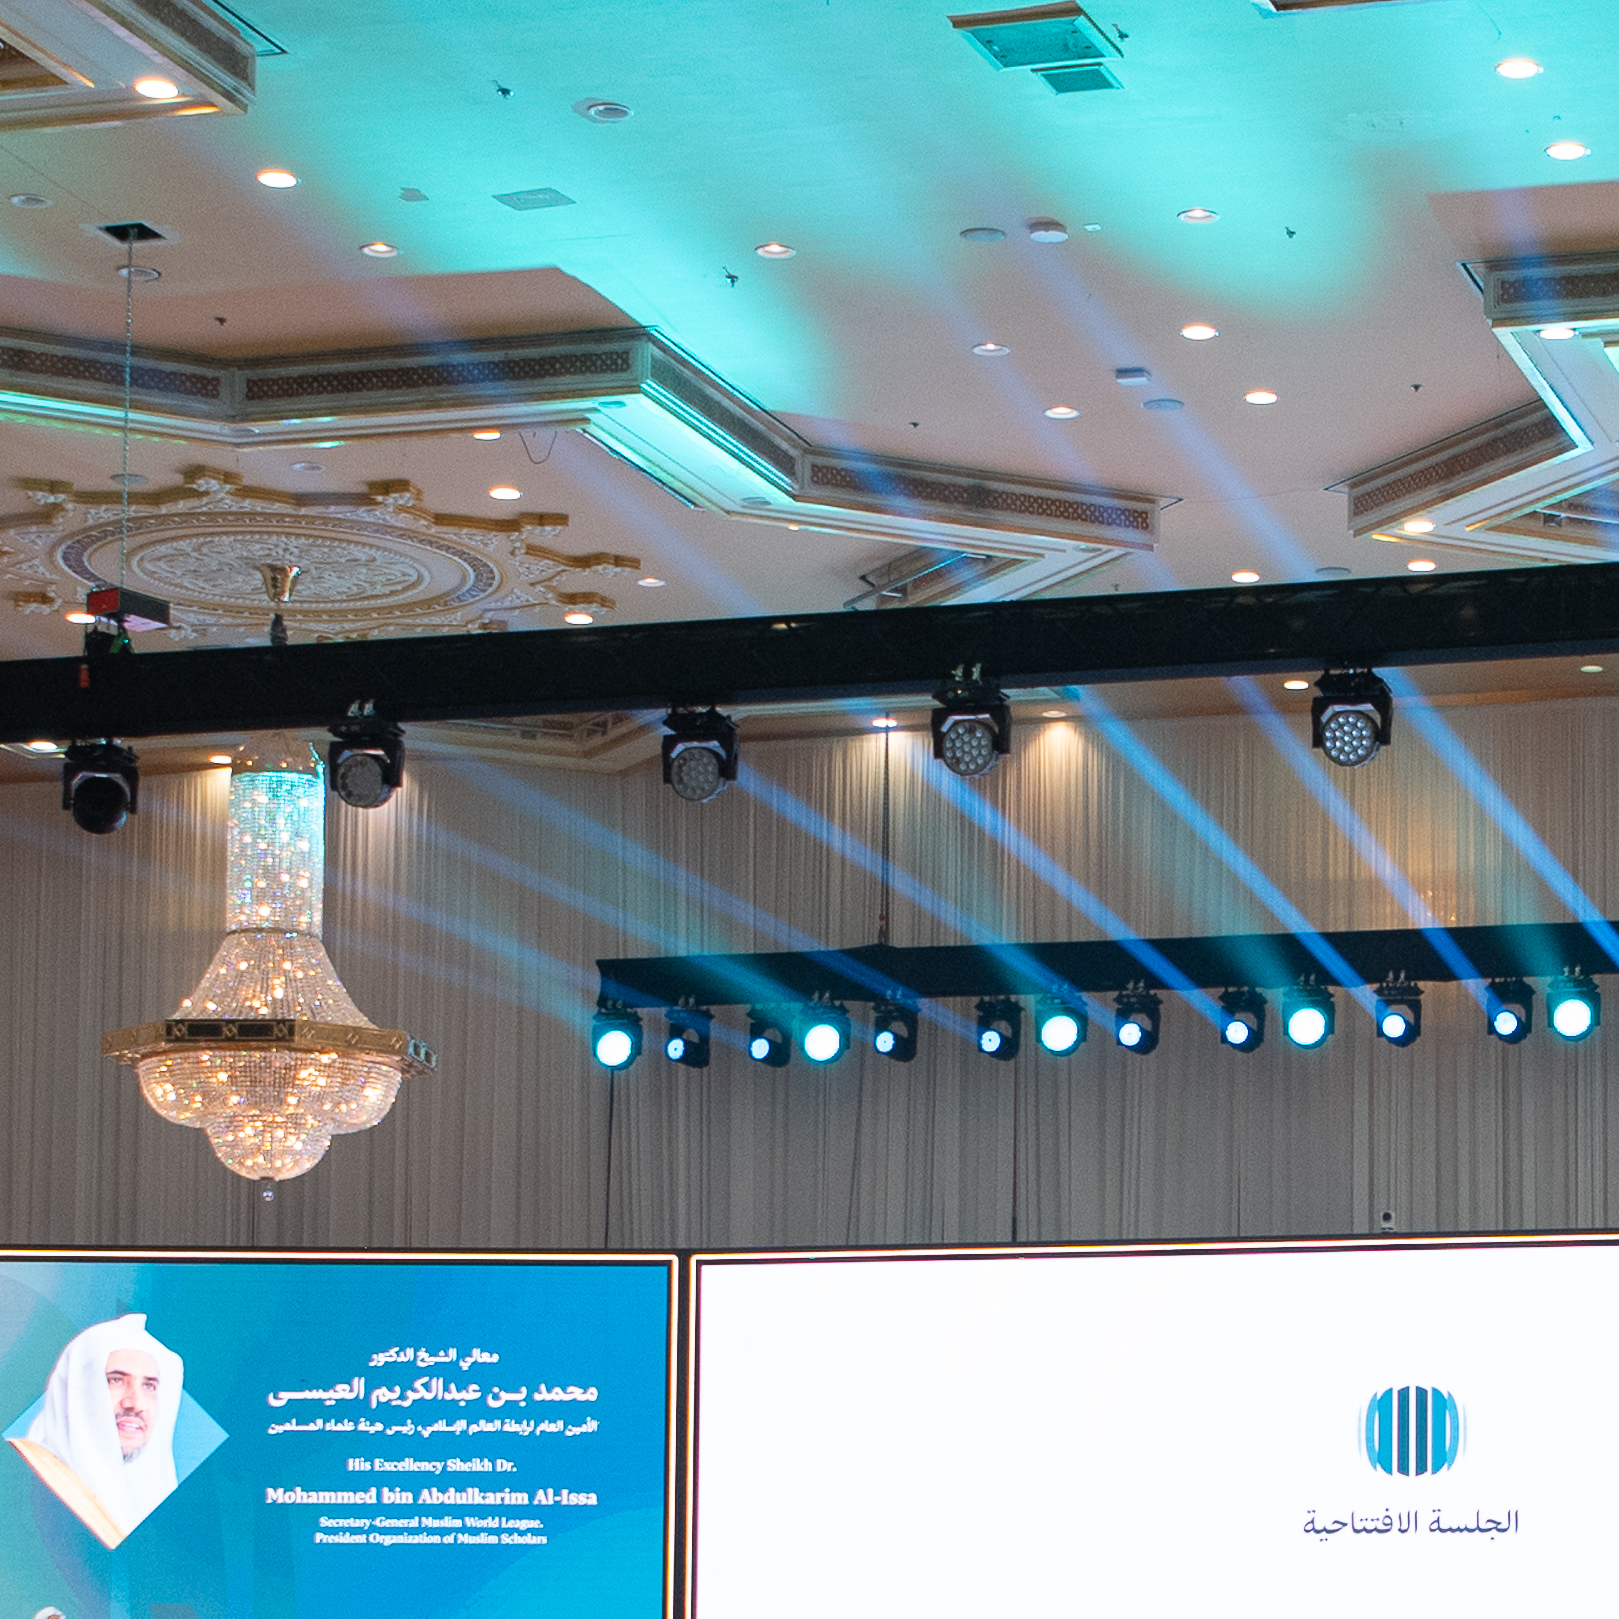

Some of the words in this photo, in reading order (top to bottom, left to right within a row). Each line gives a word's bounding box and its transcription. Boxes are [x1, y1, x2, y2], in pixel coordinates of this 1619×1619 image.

[368, 1346, 414, 1367] الدكتور
[415, 1346, 457, 1368] الشيخ
[458, 1347, 500, 1371] معالي
[266, 1376, 365, 1408] العيسى
[368, 1376, 482, 1409] عبدالكريم
[486, 1385, 528, 1409] بن
[532, 1382, 599, 1402] محمد
[267, 1417, 324, 1435] المسلمين
[324, 1417, 356, 1432] علماء
[356, 1417, 384, 1434] هيئة
[467, 1418, 502, 1436] العالم
[502, 1418, 535, 1436] لرابطة
[534, 1419, 564, 1436] العام
[564, 1416, 598, 1437] الأمين
[345, 1457, 372, 1472] His
[373, 1457, 445, 1475] Excellency
[446, 1457, 493, 1472] Sheikh
[494, 1458, 518, 1472] Dr.
[265, 1486, 378, 1504] Mohammed
[381, 1486, 414, 1504] bin
[417, 1486, 529, 1505] Abdulkarim
[533, 1487, 598, 1506] Al-Issa
[318, 1516, 419, 1530] Secretary-General
[421, 1516, 462, 1528] Muslim
[464, 1516, 499, 1528] World
[1303, 1507, 1418, 1542] الافتتاحية
[1428, 1508, 1519, 1541] الجلسة
[313, 1532, 367, 1544] President
[368, 1532, 441, 1546] Organization
[442, 1532, 456, 1544] of
[456, 1532, 499, 1544] Muslim
[500, 1532, 548, 1544] Scholars
